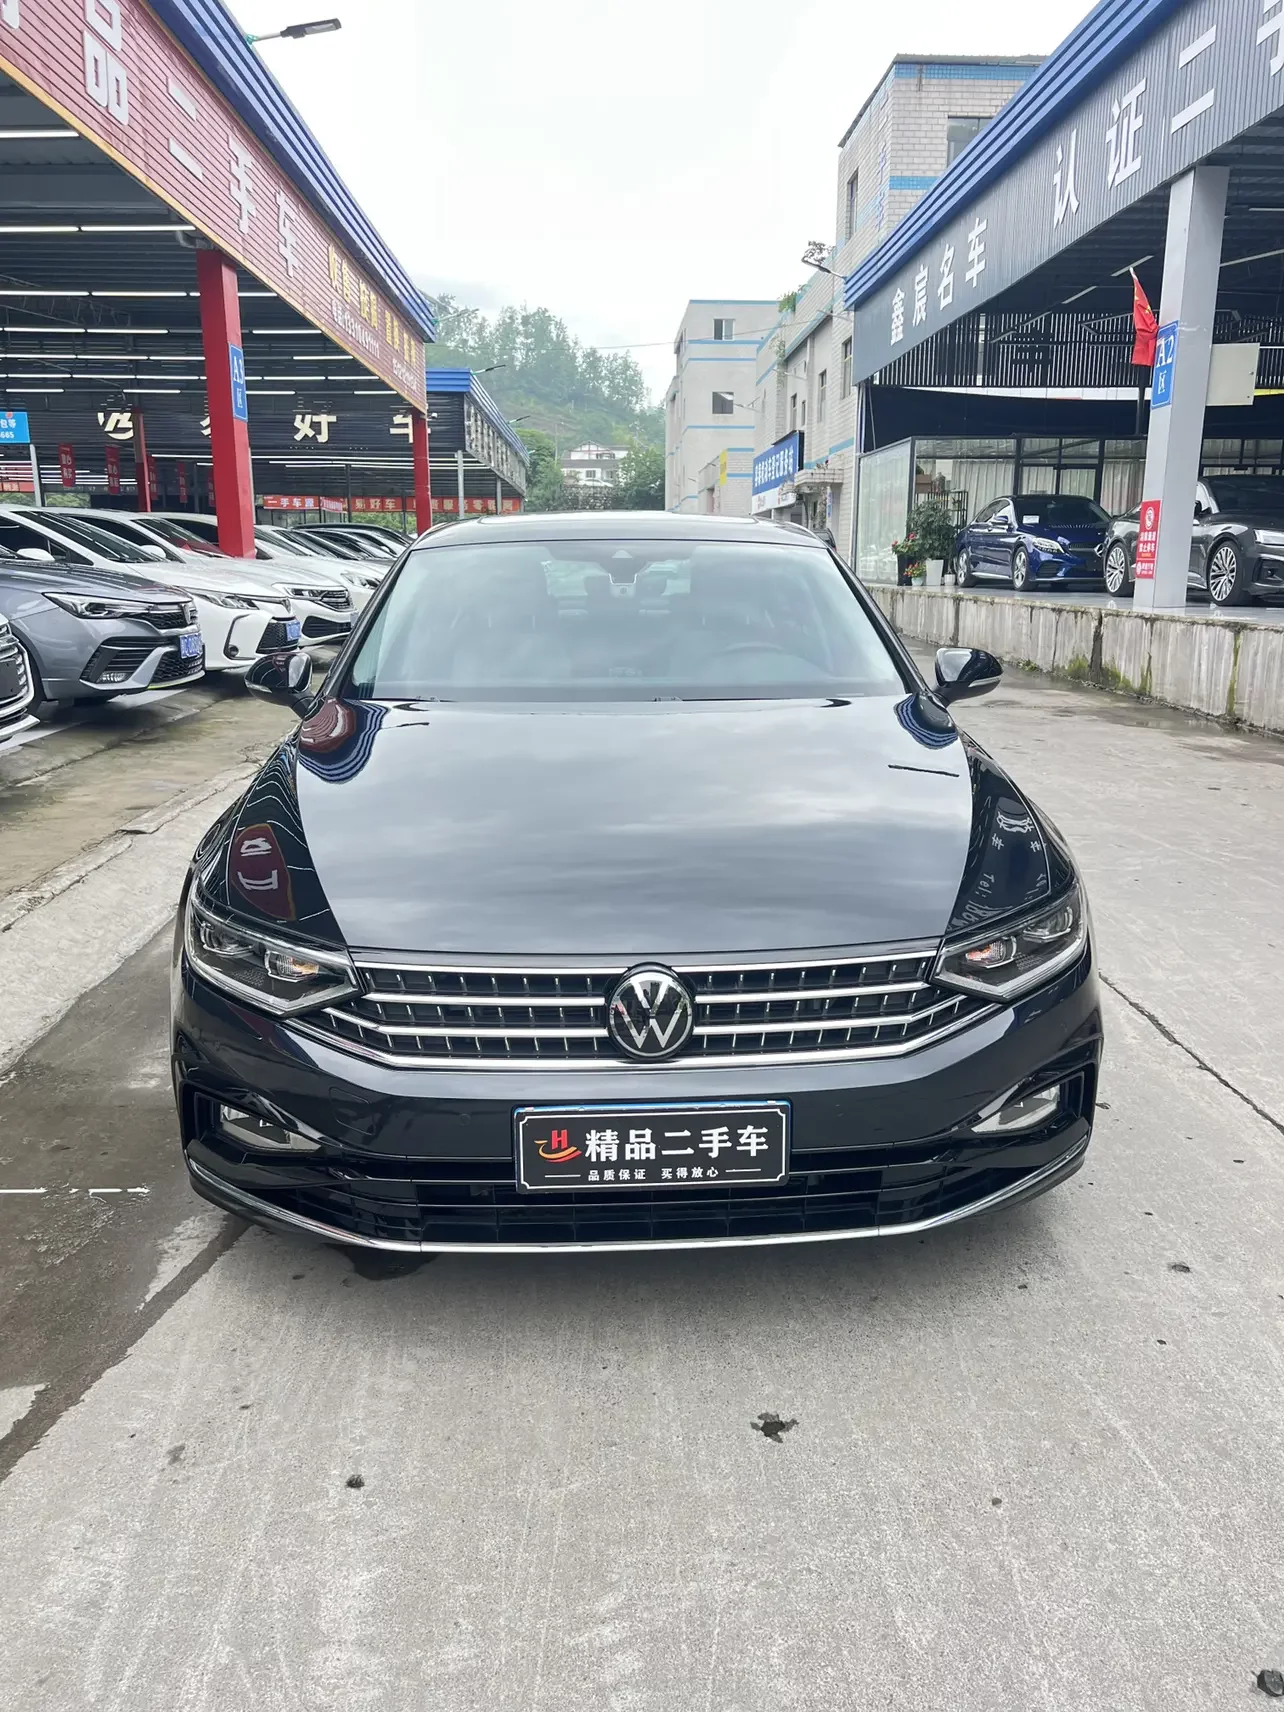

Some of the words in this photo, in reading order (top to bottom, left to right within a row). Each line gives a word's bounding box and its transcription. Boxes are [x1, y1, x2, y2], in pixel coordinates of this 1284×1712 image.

[1156, 334, 1174, 368] A2
[233, 355, 244, 384] A3
[1158, 370, 1167, 394] 区
[585, 1125, 769, 1162] 精品二手车
[588, 1168, 647, 1182] 品质保证
[661, 1166, 719, 1179] 买得放心
